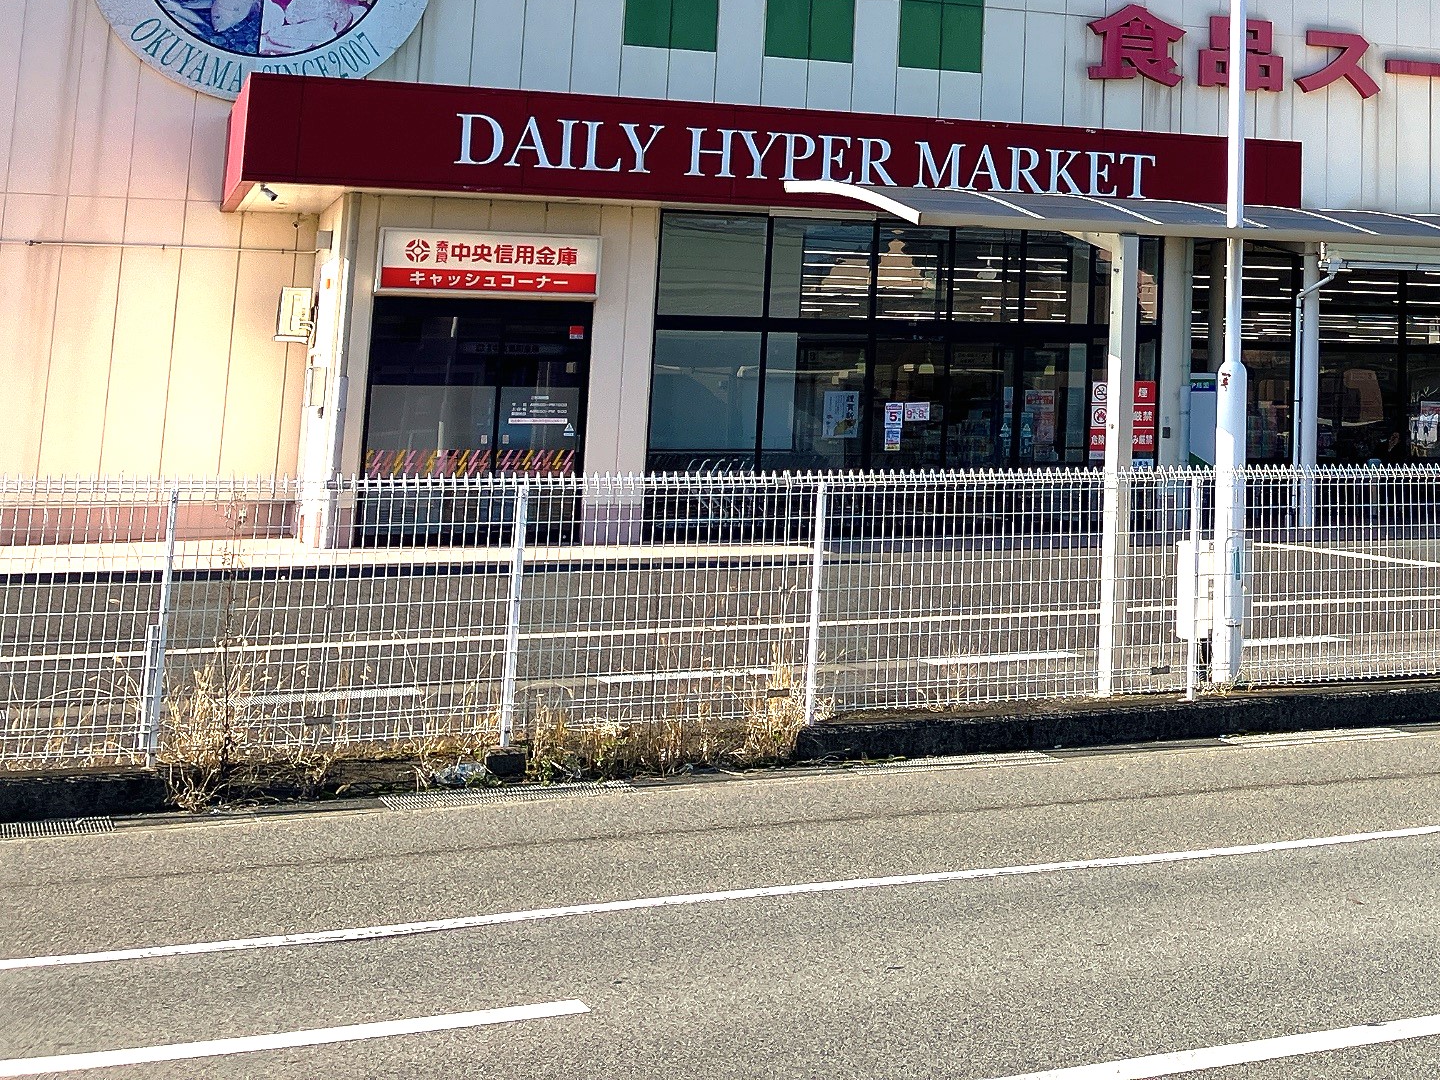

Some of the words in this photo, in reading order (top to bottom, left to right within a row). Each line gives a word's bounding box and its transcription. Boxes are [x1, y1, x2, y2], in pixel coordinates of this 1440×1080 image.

[130, 18, 243, 93] OKUYAMA
[453, 111, 665, 174] DAILY
[683, 126, 898, 187] HYPER
[913, 139, 1158, 199] MARKET
[408, 270, 569, 289] キャッシュコーナー
